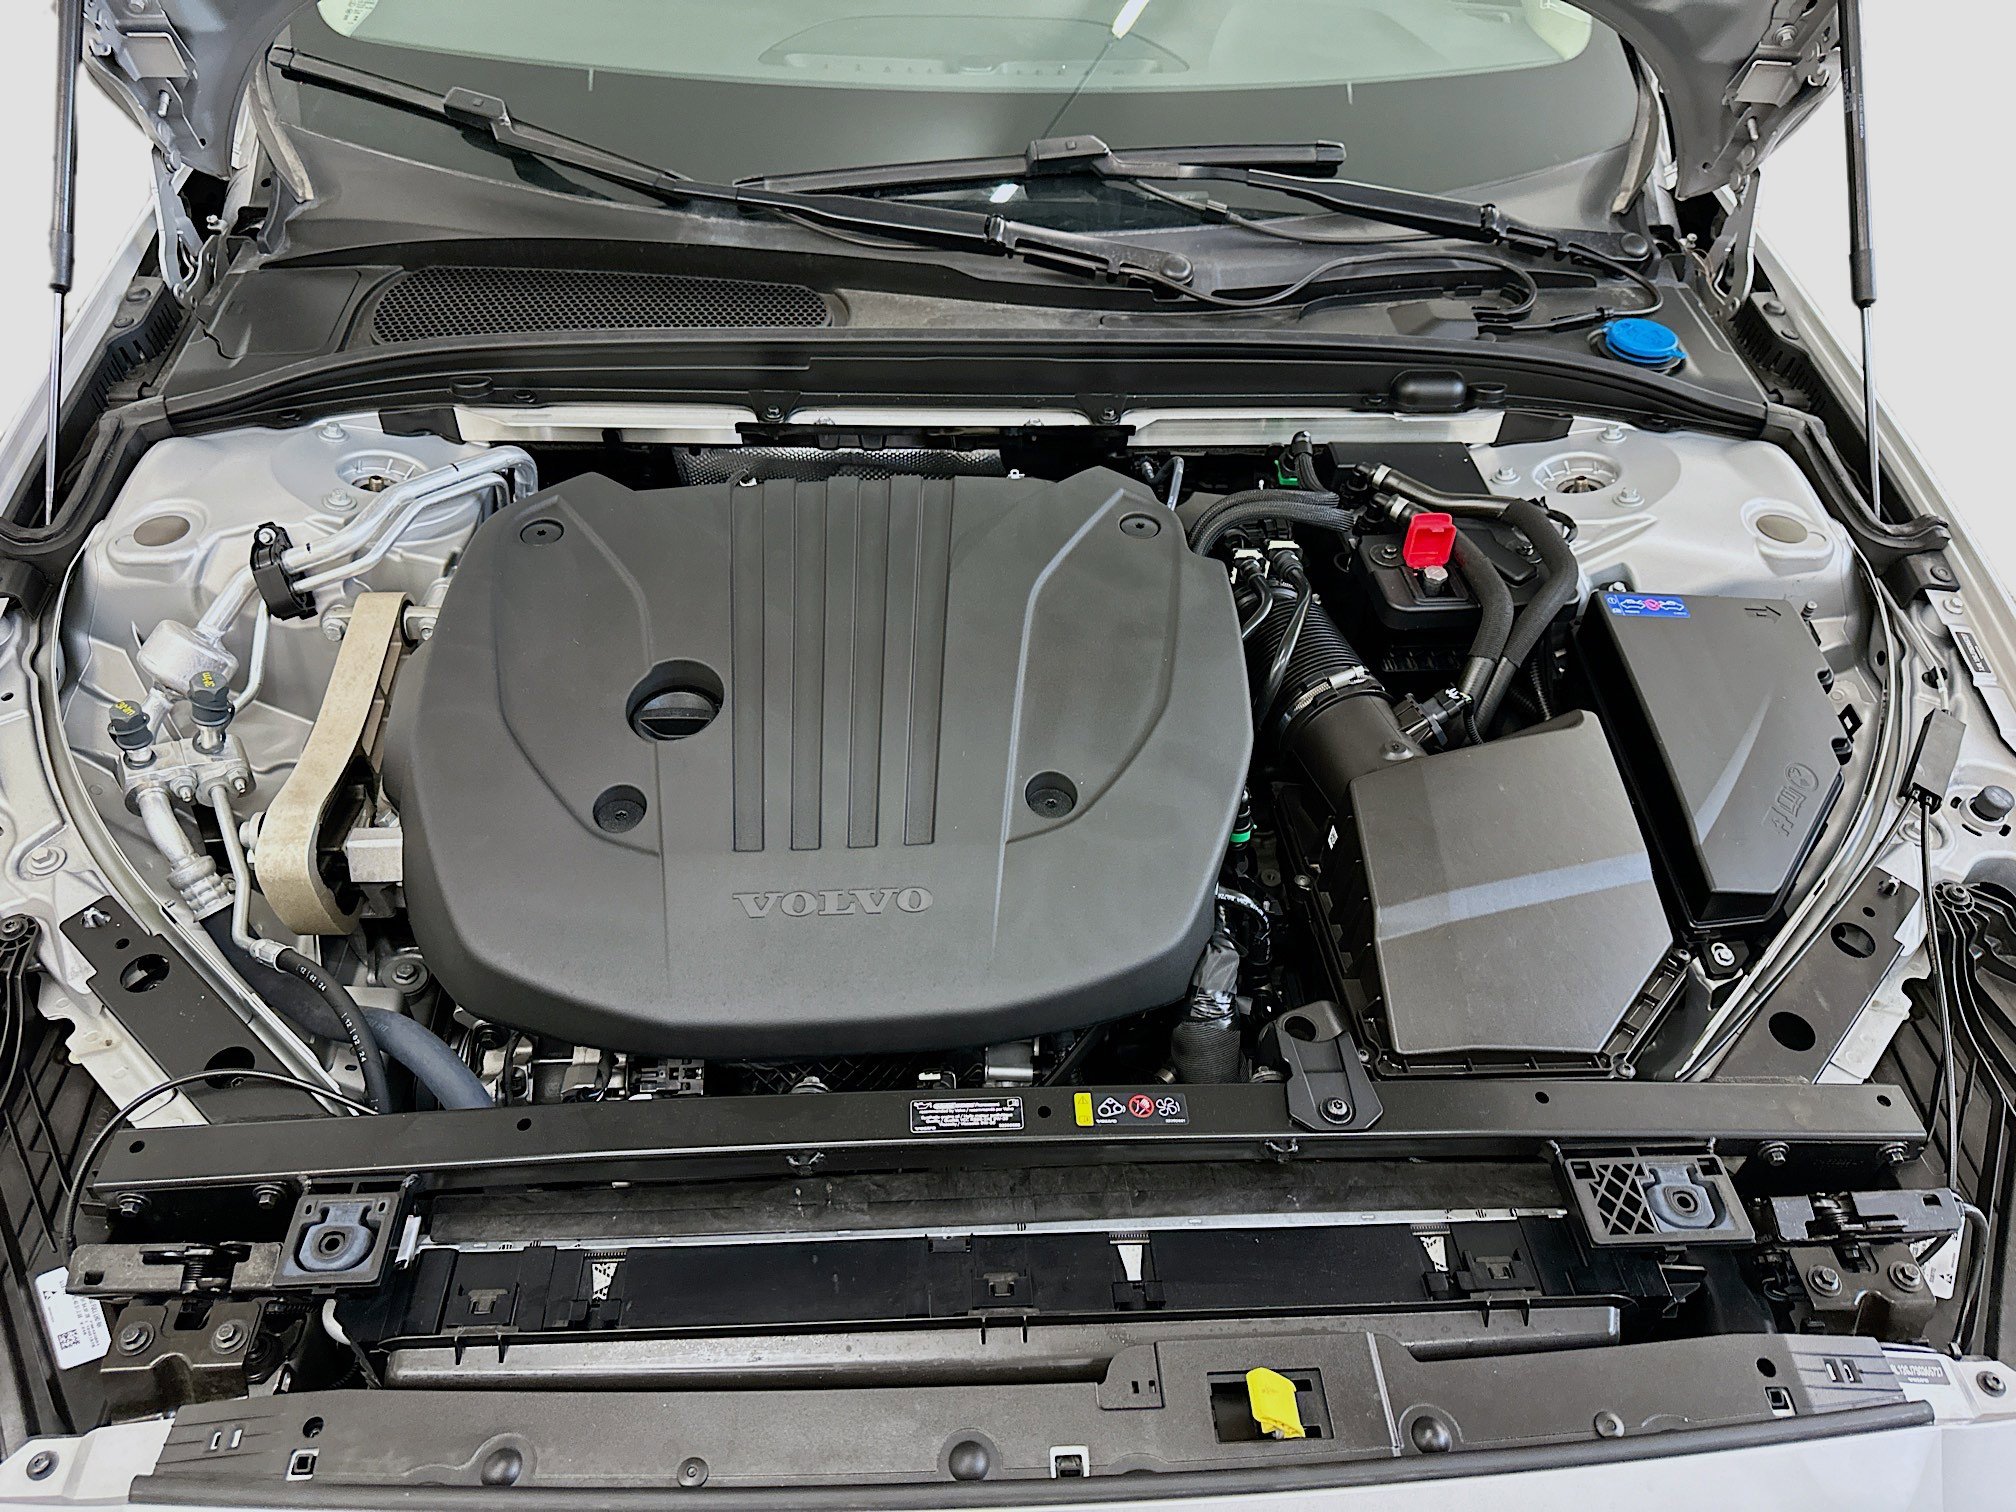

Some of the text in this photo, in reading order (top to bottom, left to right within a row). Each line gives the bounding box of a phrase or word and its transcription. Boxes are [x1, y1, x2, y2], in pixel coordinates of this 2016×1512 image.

[732, 886, 934, 918] VOLVO
[345, 1018, 353, 1028] 12
[352, 1034, 361, 1045] 02
